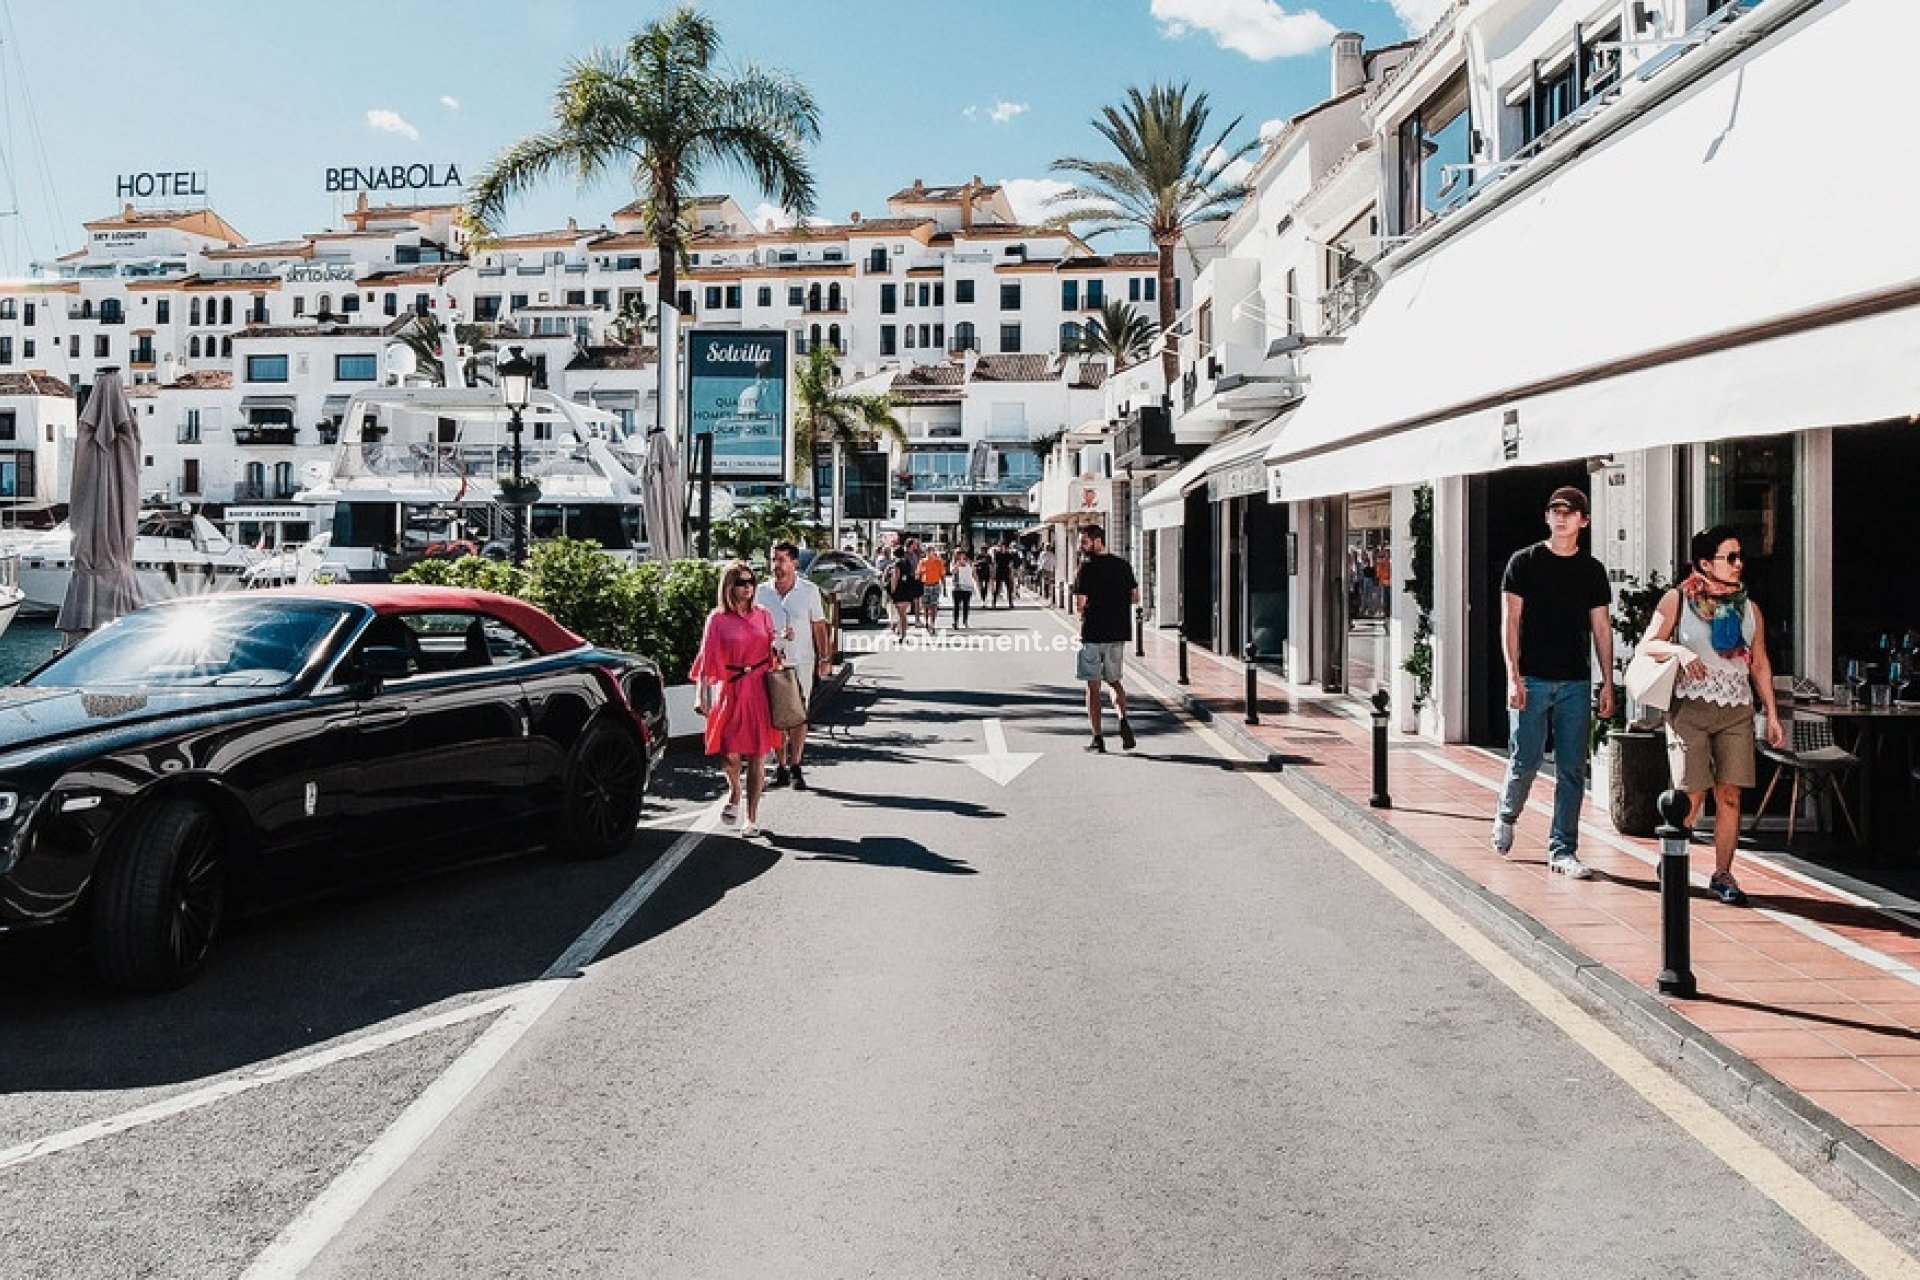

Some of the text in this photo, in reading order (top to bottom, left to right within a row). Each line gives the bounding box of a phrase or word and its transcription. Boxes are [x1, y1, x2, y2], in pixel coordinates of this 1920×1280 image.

[117, 172, 206, 198] HOTEL
[326, 164, 462, 191] BENABOLA
[94, 231, 148, 242] SKY LOUNGE
[286, 267, 354, 282] SKY LOUNGE
[706, 341, 772, 362] Solvilla
